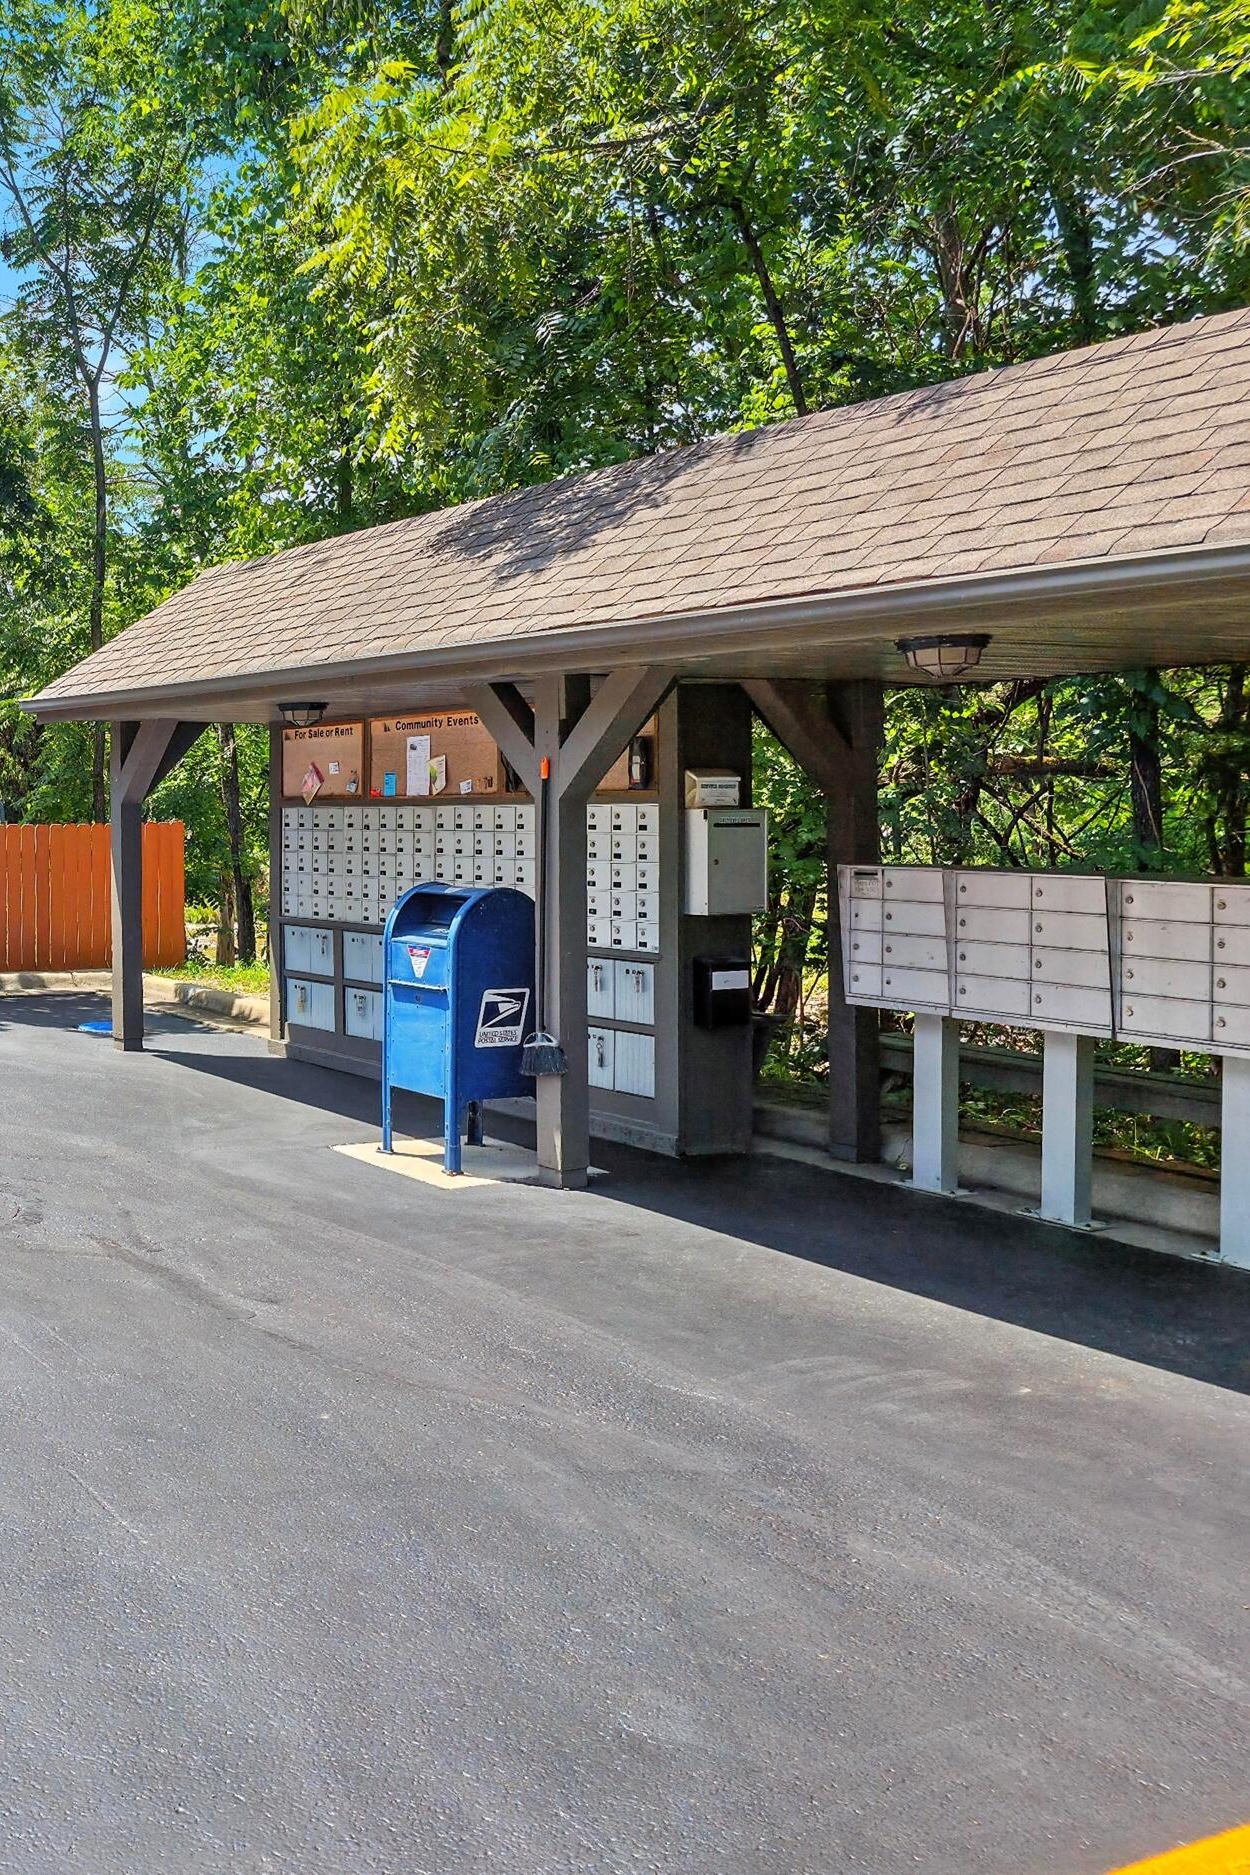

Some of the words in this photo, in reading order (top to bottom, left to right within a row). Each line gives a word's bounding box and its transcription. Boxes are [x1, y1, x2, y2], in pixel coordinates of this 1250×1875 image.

[395, 717, 443, 731] Community
[447, 715, 479, 726] Events
[294, 730, 308, 740] For
[308, 729, 324, 738] Sale
[334, 727, 353, 737] Rent
